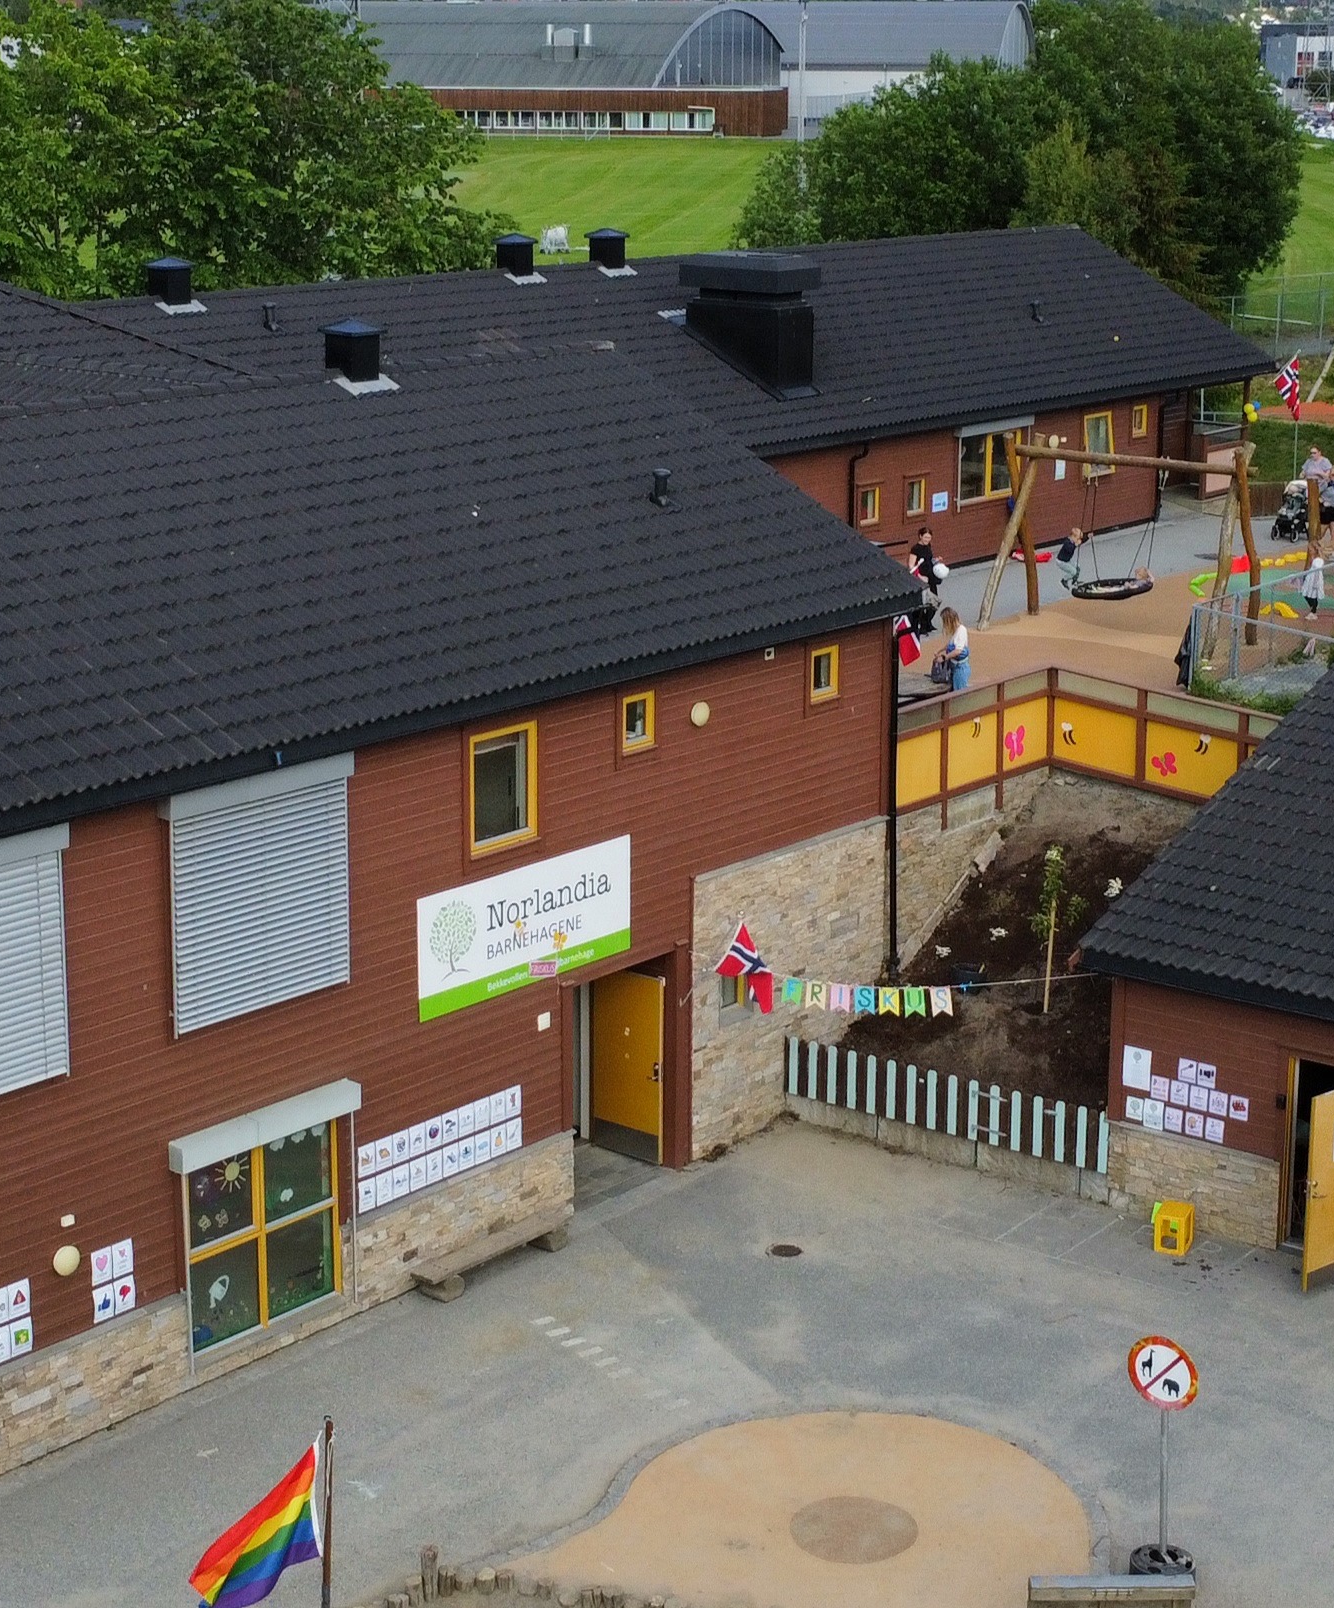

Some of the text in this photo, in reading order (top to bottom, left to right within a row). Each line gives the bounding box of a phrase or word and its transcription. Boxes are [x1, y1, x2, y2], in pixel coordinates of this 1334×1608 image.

[486, 872, 612, 932] Norlandia
[487, 914, 582, 960] BARNEHAGENE
[786, 979, 947, 1010] FRISKUS
